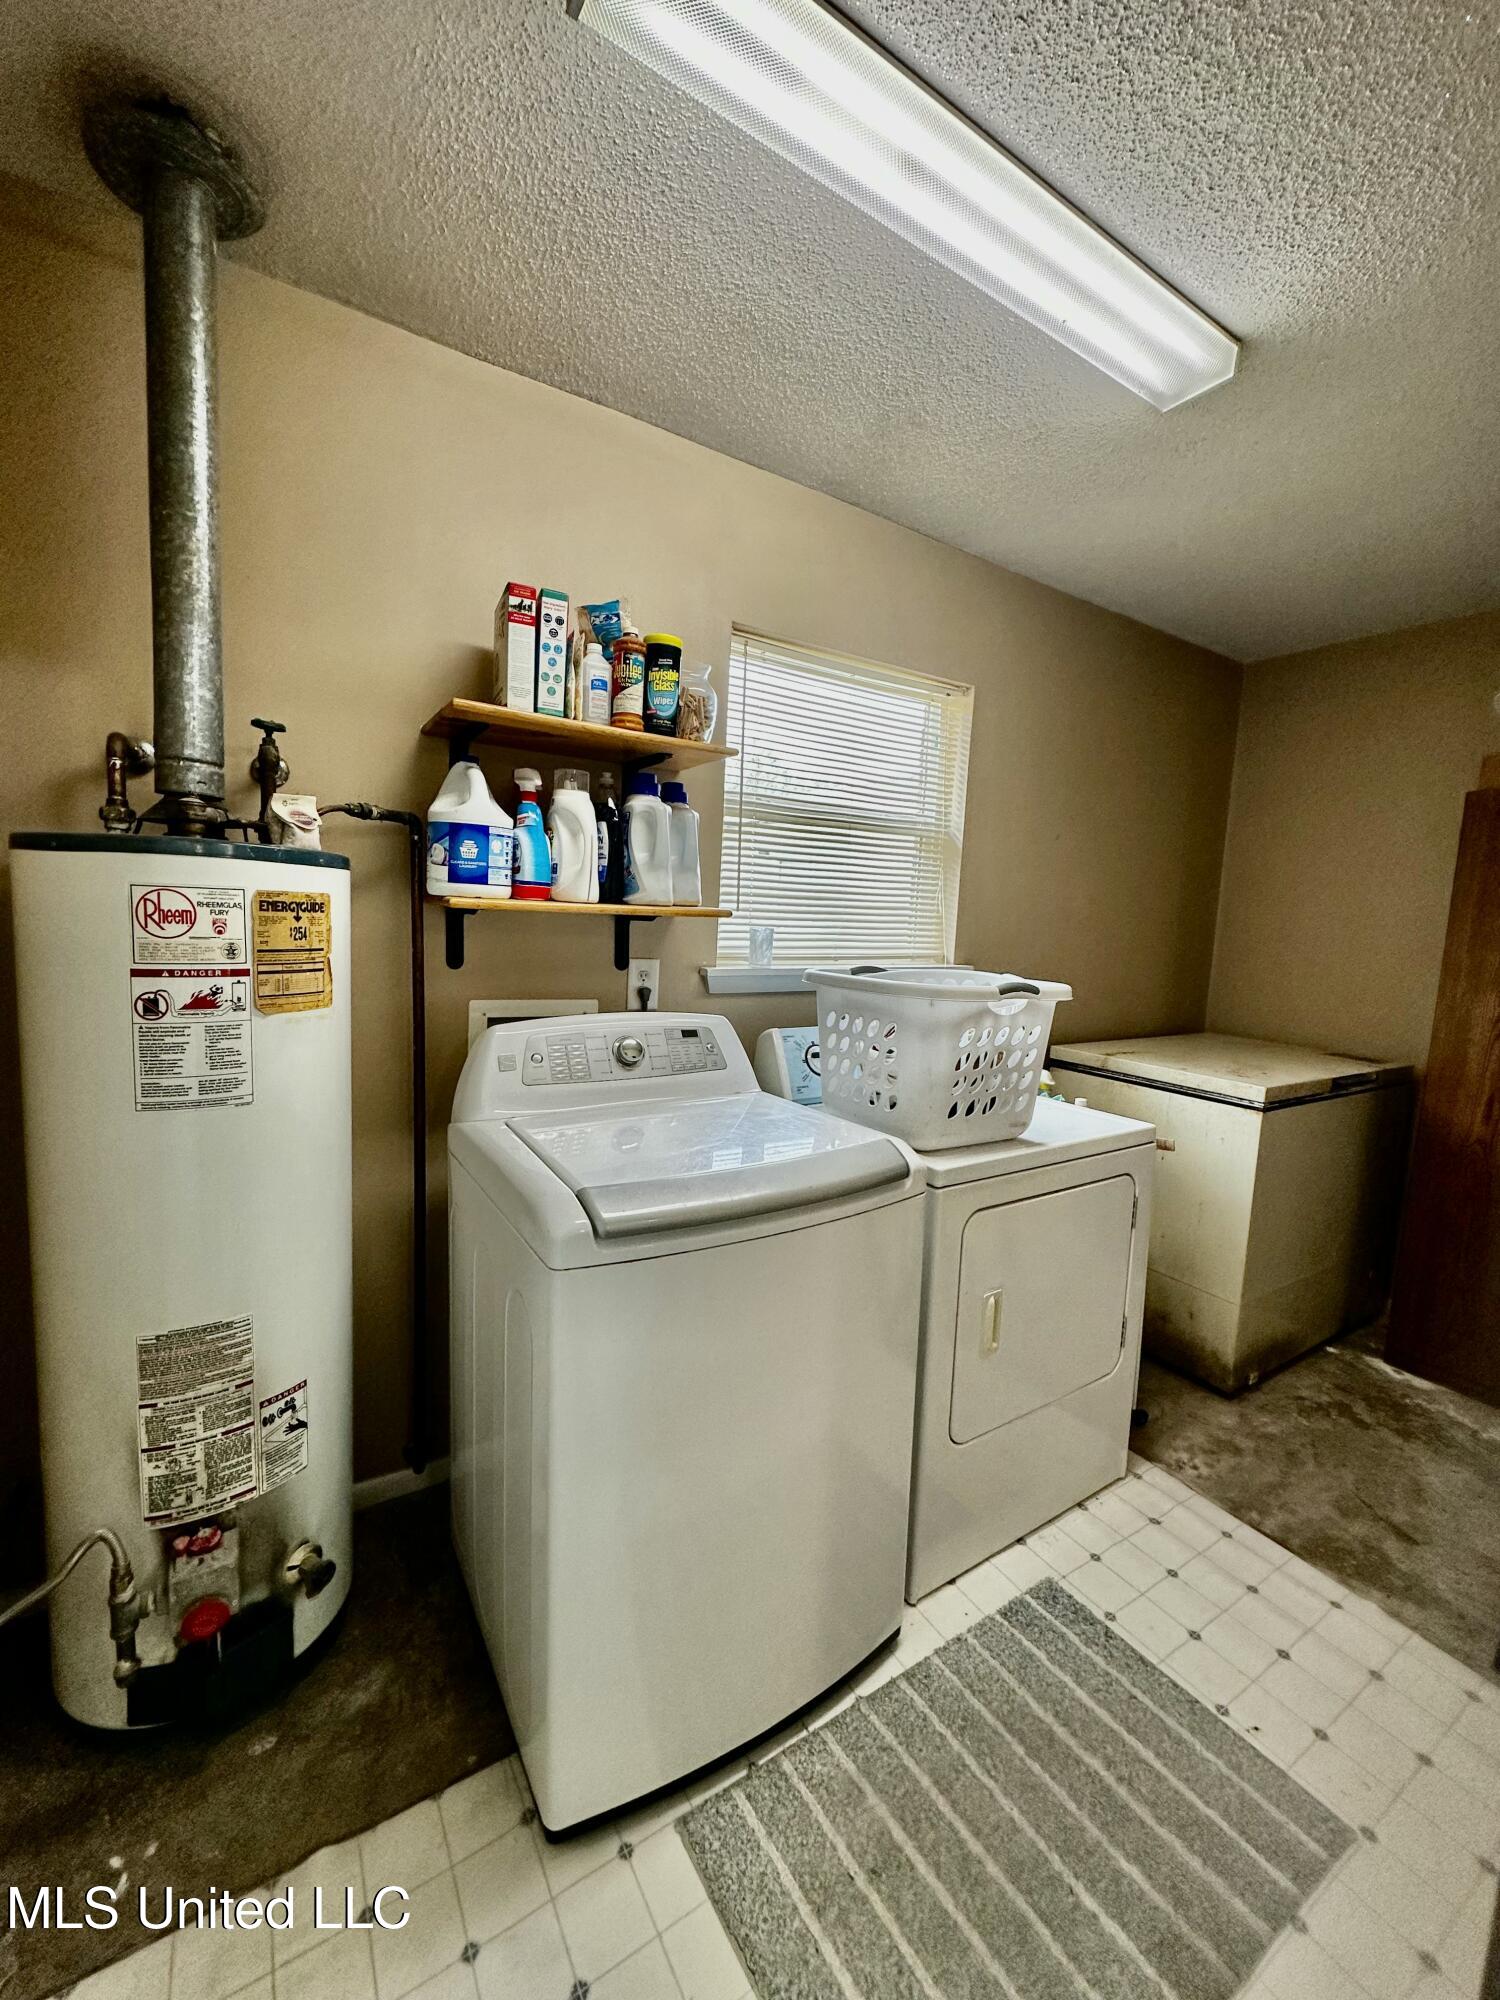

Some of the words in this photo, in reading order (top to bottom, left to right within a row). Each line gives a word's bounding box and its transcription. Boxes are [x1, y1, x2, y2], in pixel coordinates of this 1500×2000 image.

[649, 669, 679, 681] Invisible
[653, 680, 675, 691] Glass
[653, 696, 674, 705] Wipes
[143, 891, 193, 930] Rheem
[174, 968, 222, 977] DANGER
[271, 1381, 306, 1403] DANGER
